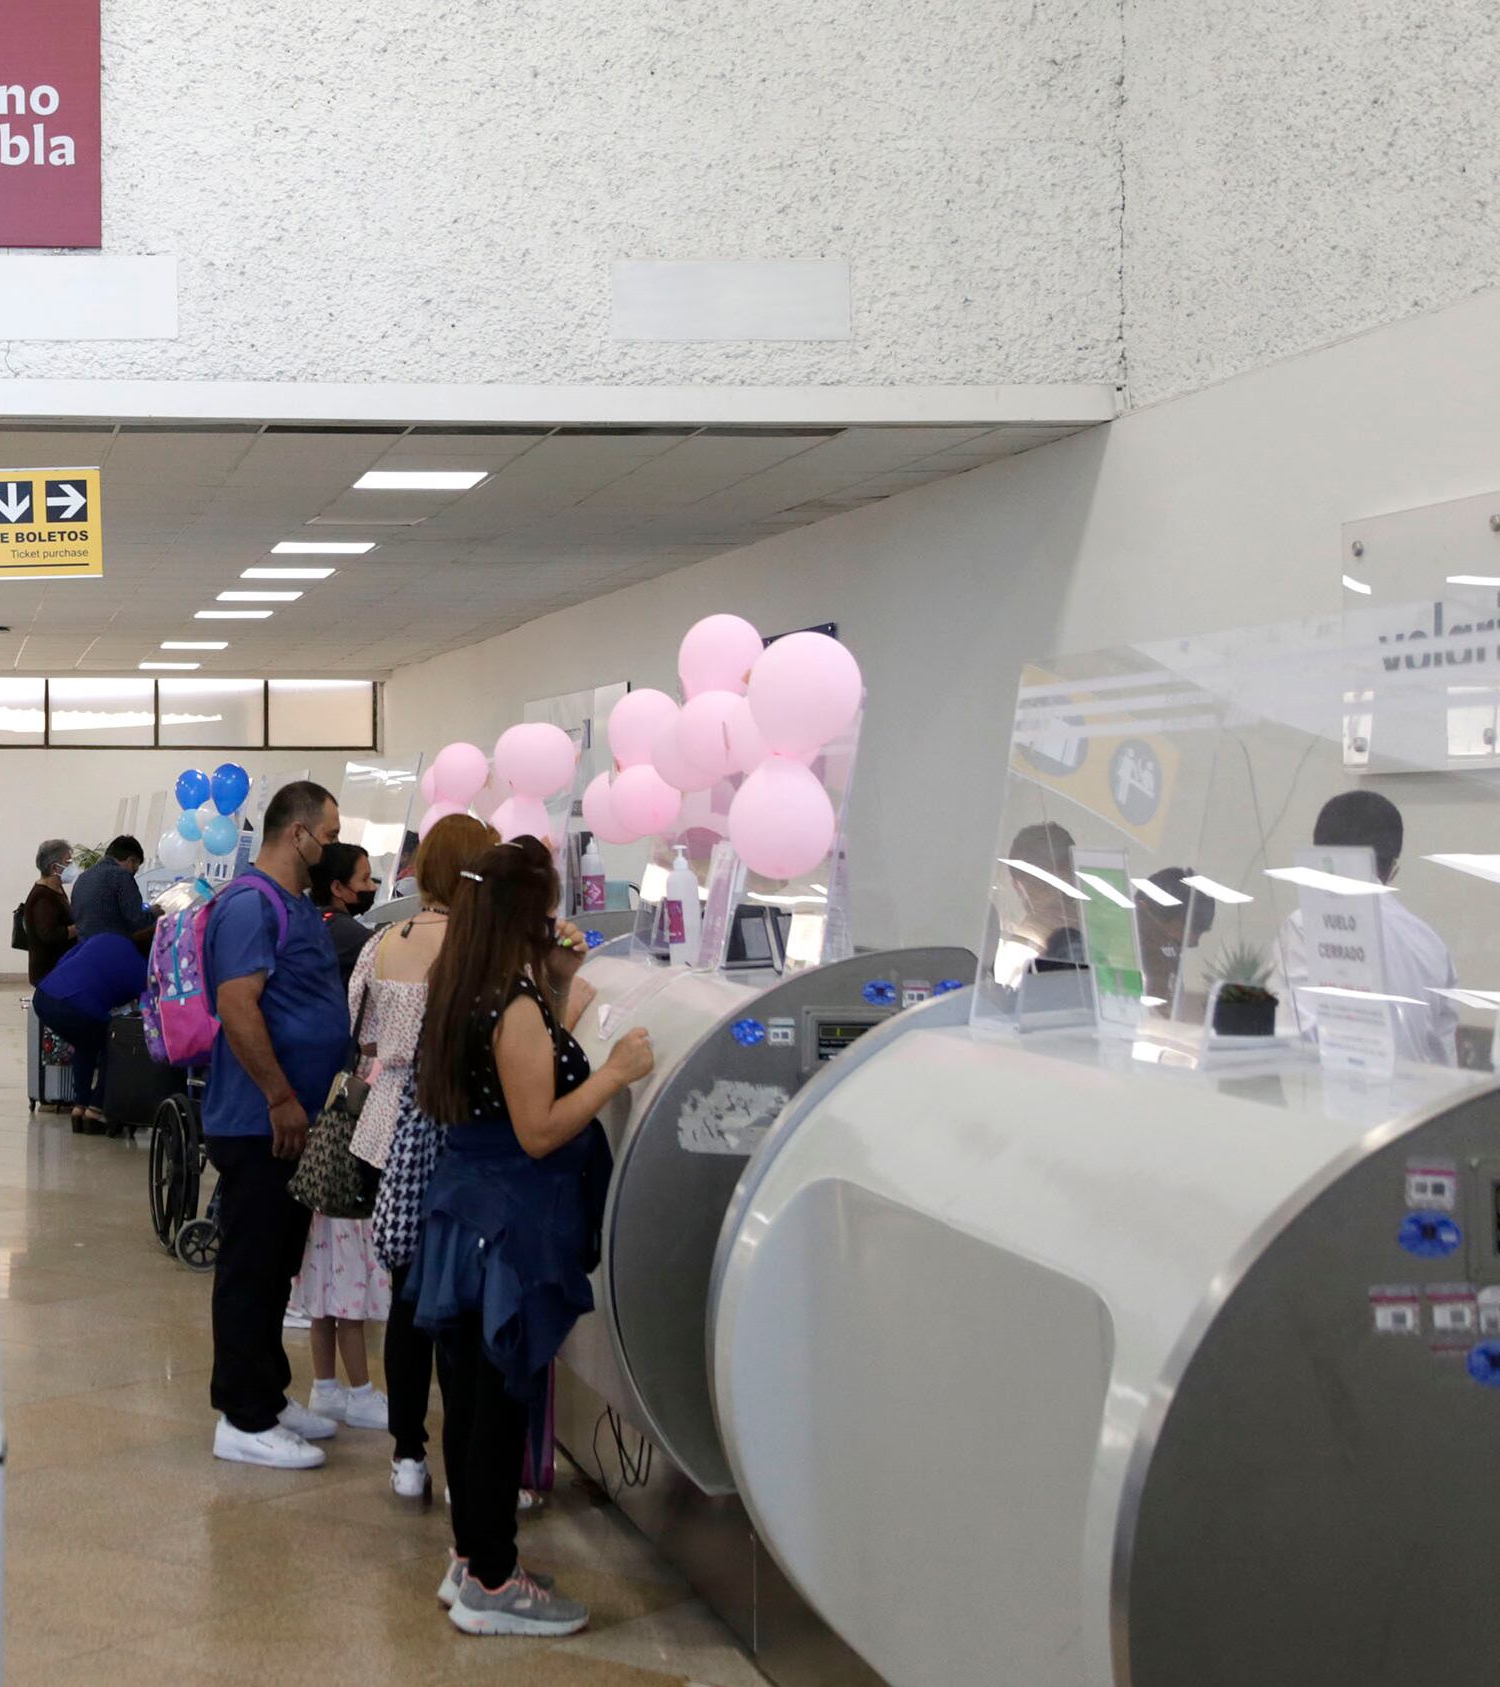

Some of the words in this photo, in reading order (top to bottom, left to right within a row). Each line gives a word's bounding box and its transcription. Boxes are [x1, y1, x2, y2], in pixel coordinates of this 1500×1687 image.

[15, 530, 89, 543] BOLETOS
[10, 549, 39, 559] Ticket
[42, 548, 88, 560] purchase
[1322, 914, 1356, 931] VUELO
[1318, 942, 1364, 962] CERRADO
